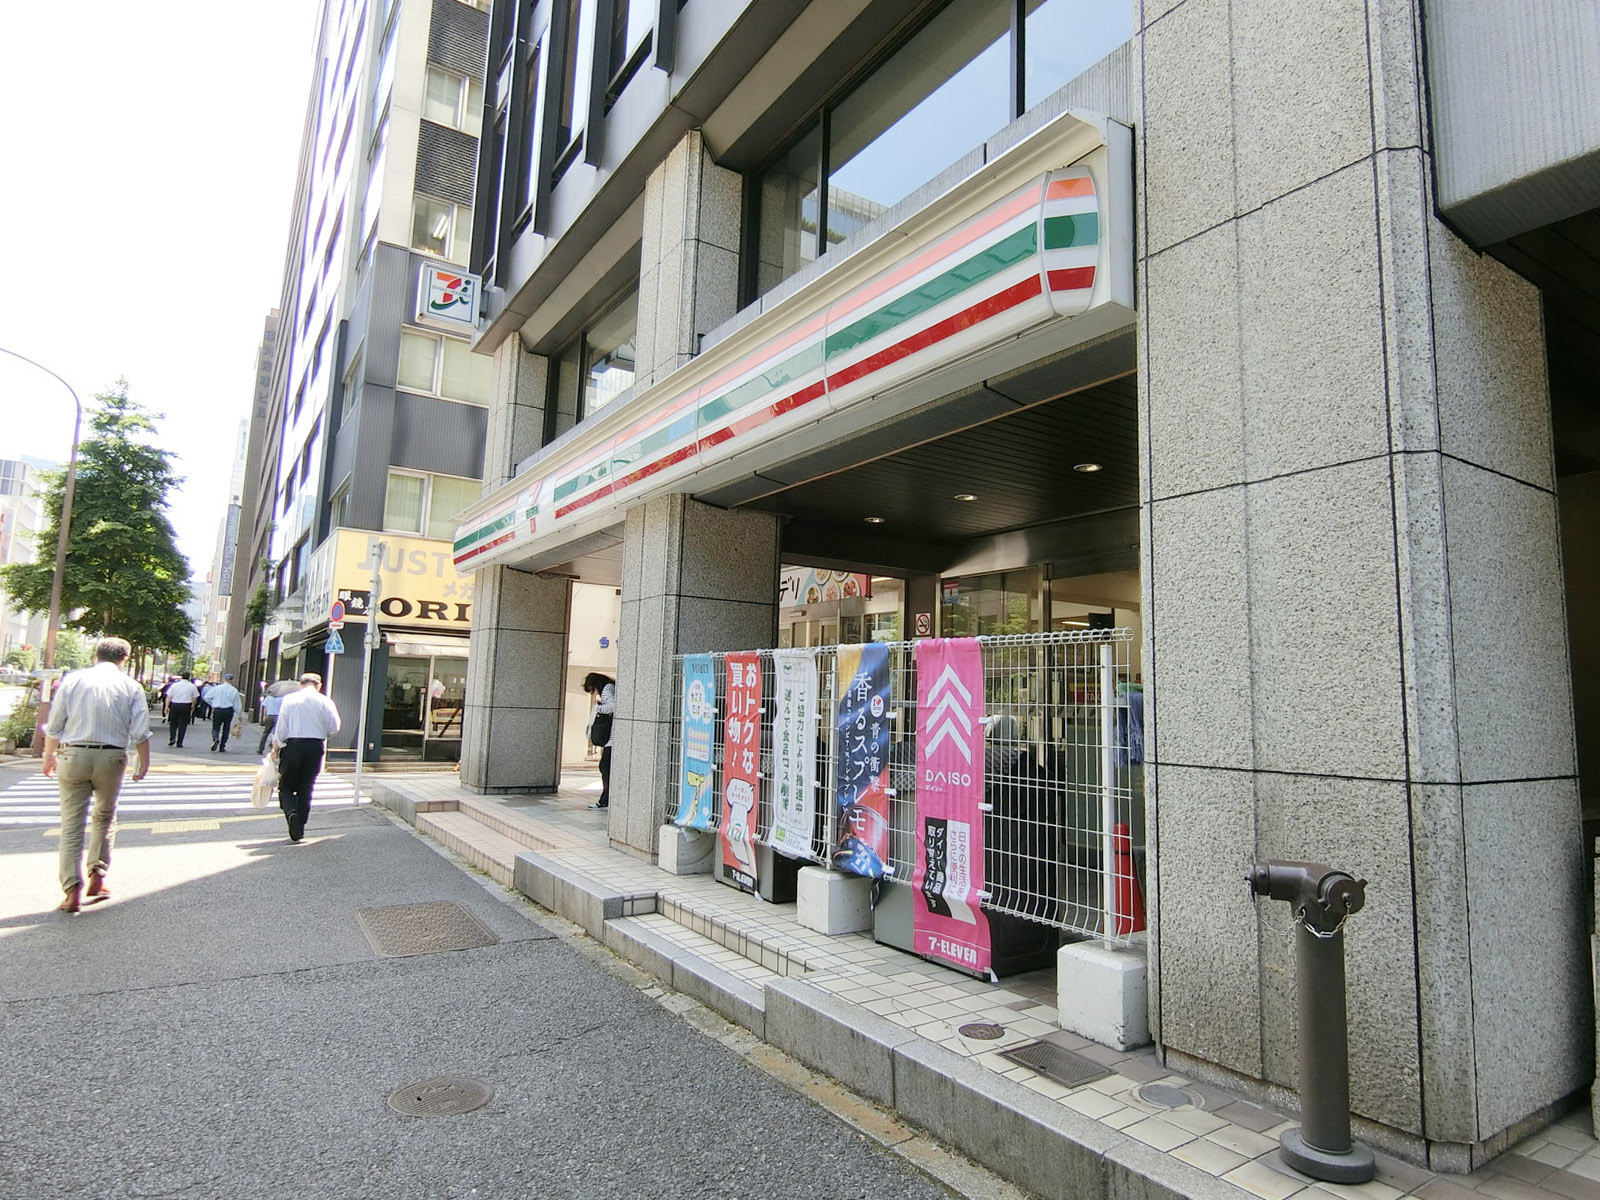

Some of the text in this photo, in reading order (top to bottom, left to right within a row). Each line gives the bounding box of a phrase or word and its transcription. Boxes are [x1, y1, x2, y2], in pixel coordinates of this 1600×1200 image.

[742, 663, 757, 774] おトクな
[869, 722, 881, 793] 青の衝撃
[925, 769, 971, 787] DAISO
